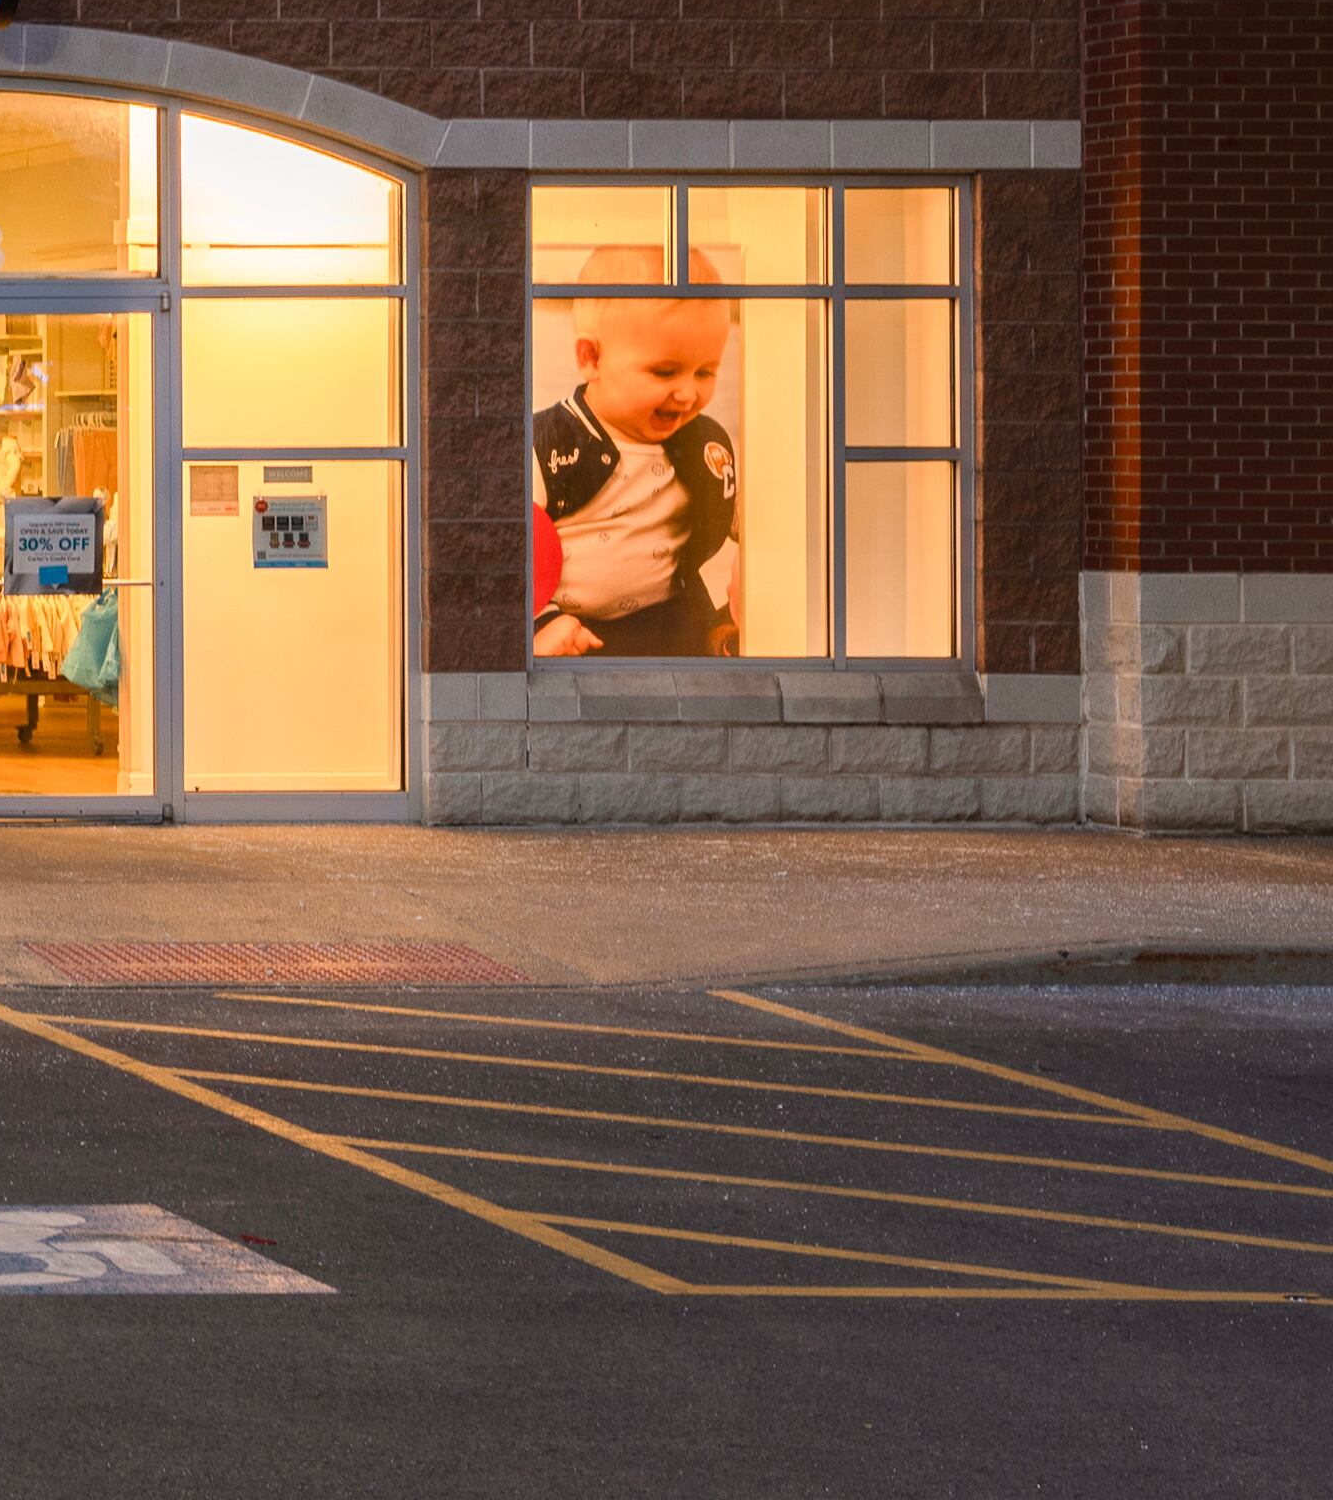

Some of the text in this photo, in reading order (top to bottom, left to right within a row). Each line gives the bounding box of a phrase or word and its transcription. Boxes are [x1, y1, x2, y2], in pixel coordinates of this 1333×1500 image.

[268, 467, 309, 478] WELCOME
[18, 537, 90, 551] 30% OFF
